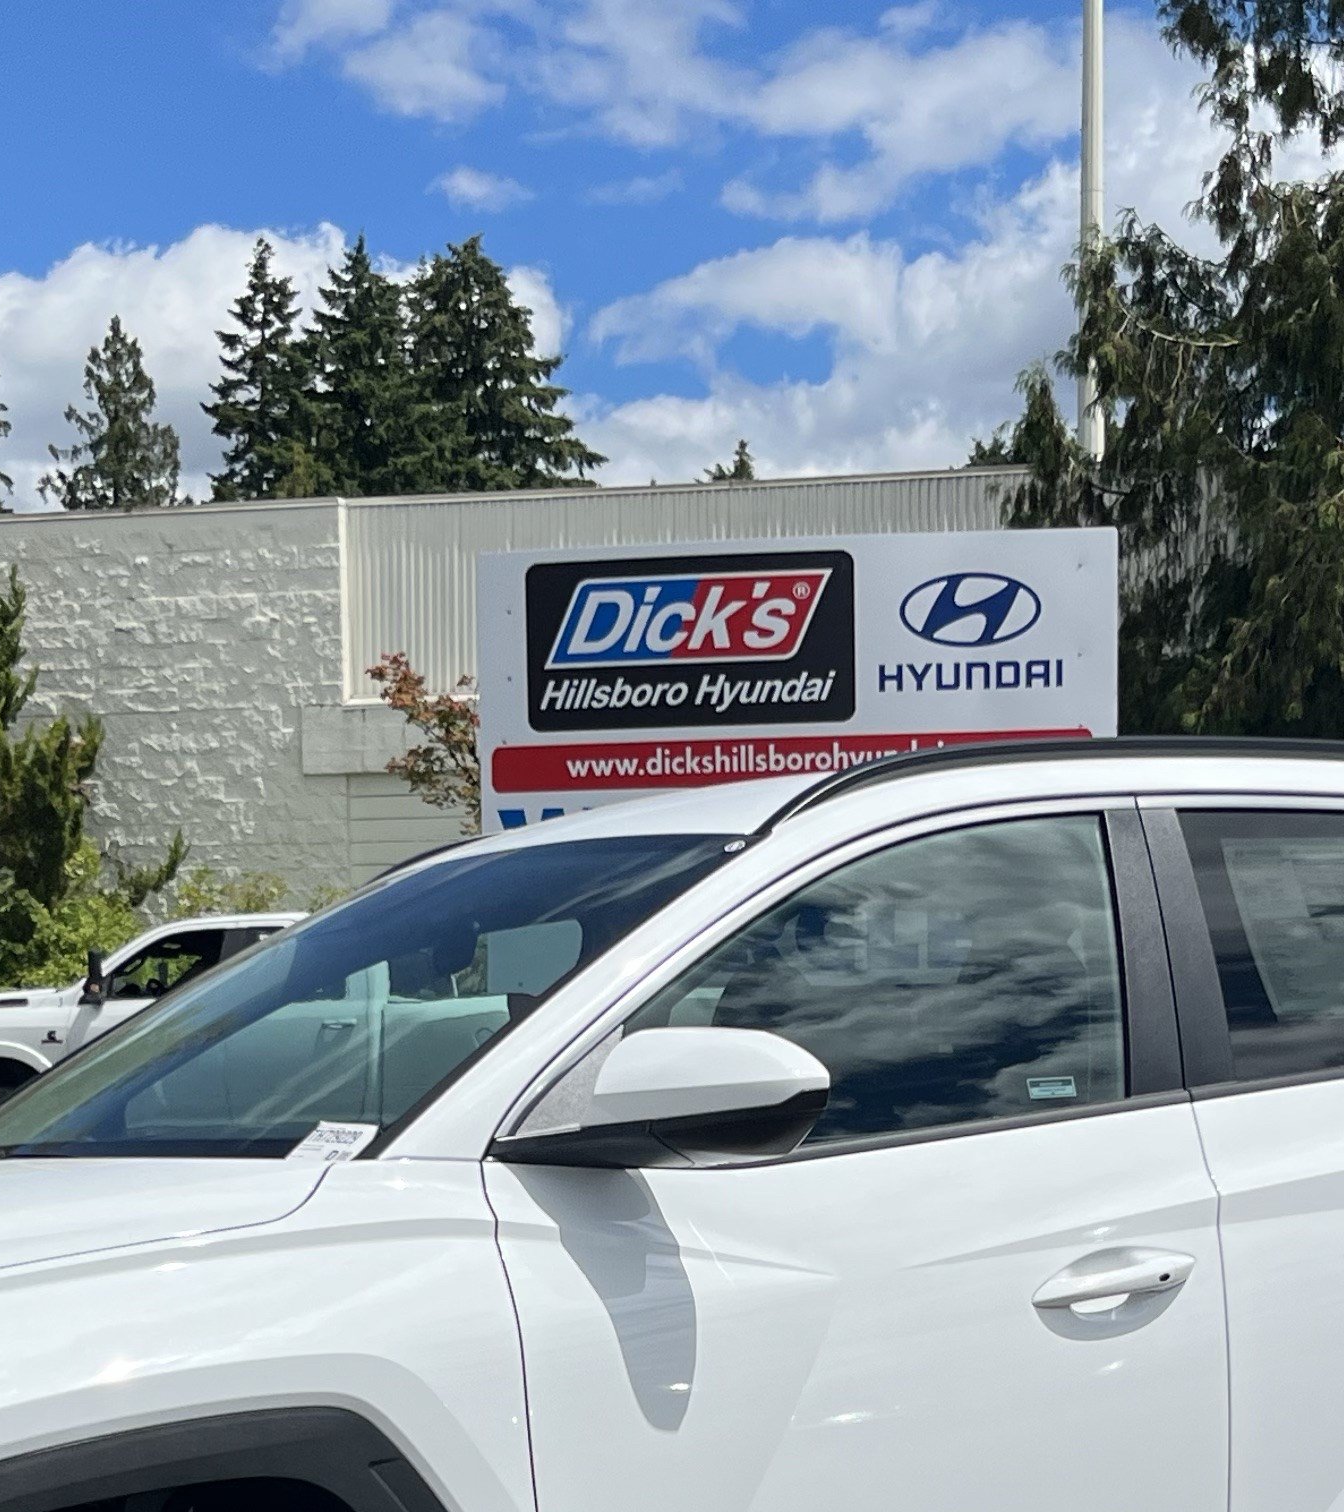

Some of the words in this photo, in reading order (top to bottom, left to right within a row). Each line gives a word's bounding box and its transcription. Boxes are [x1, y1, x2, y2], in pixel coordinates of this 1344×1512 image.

[539, 676, 689, 711] Hillsboro
[694, 669, 837, 713] Hyundai
[878, 659, 1063, 693] HYUNDAI
